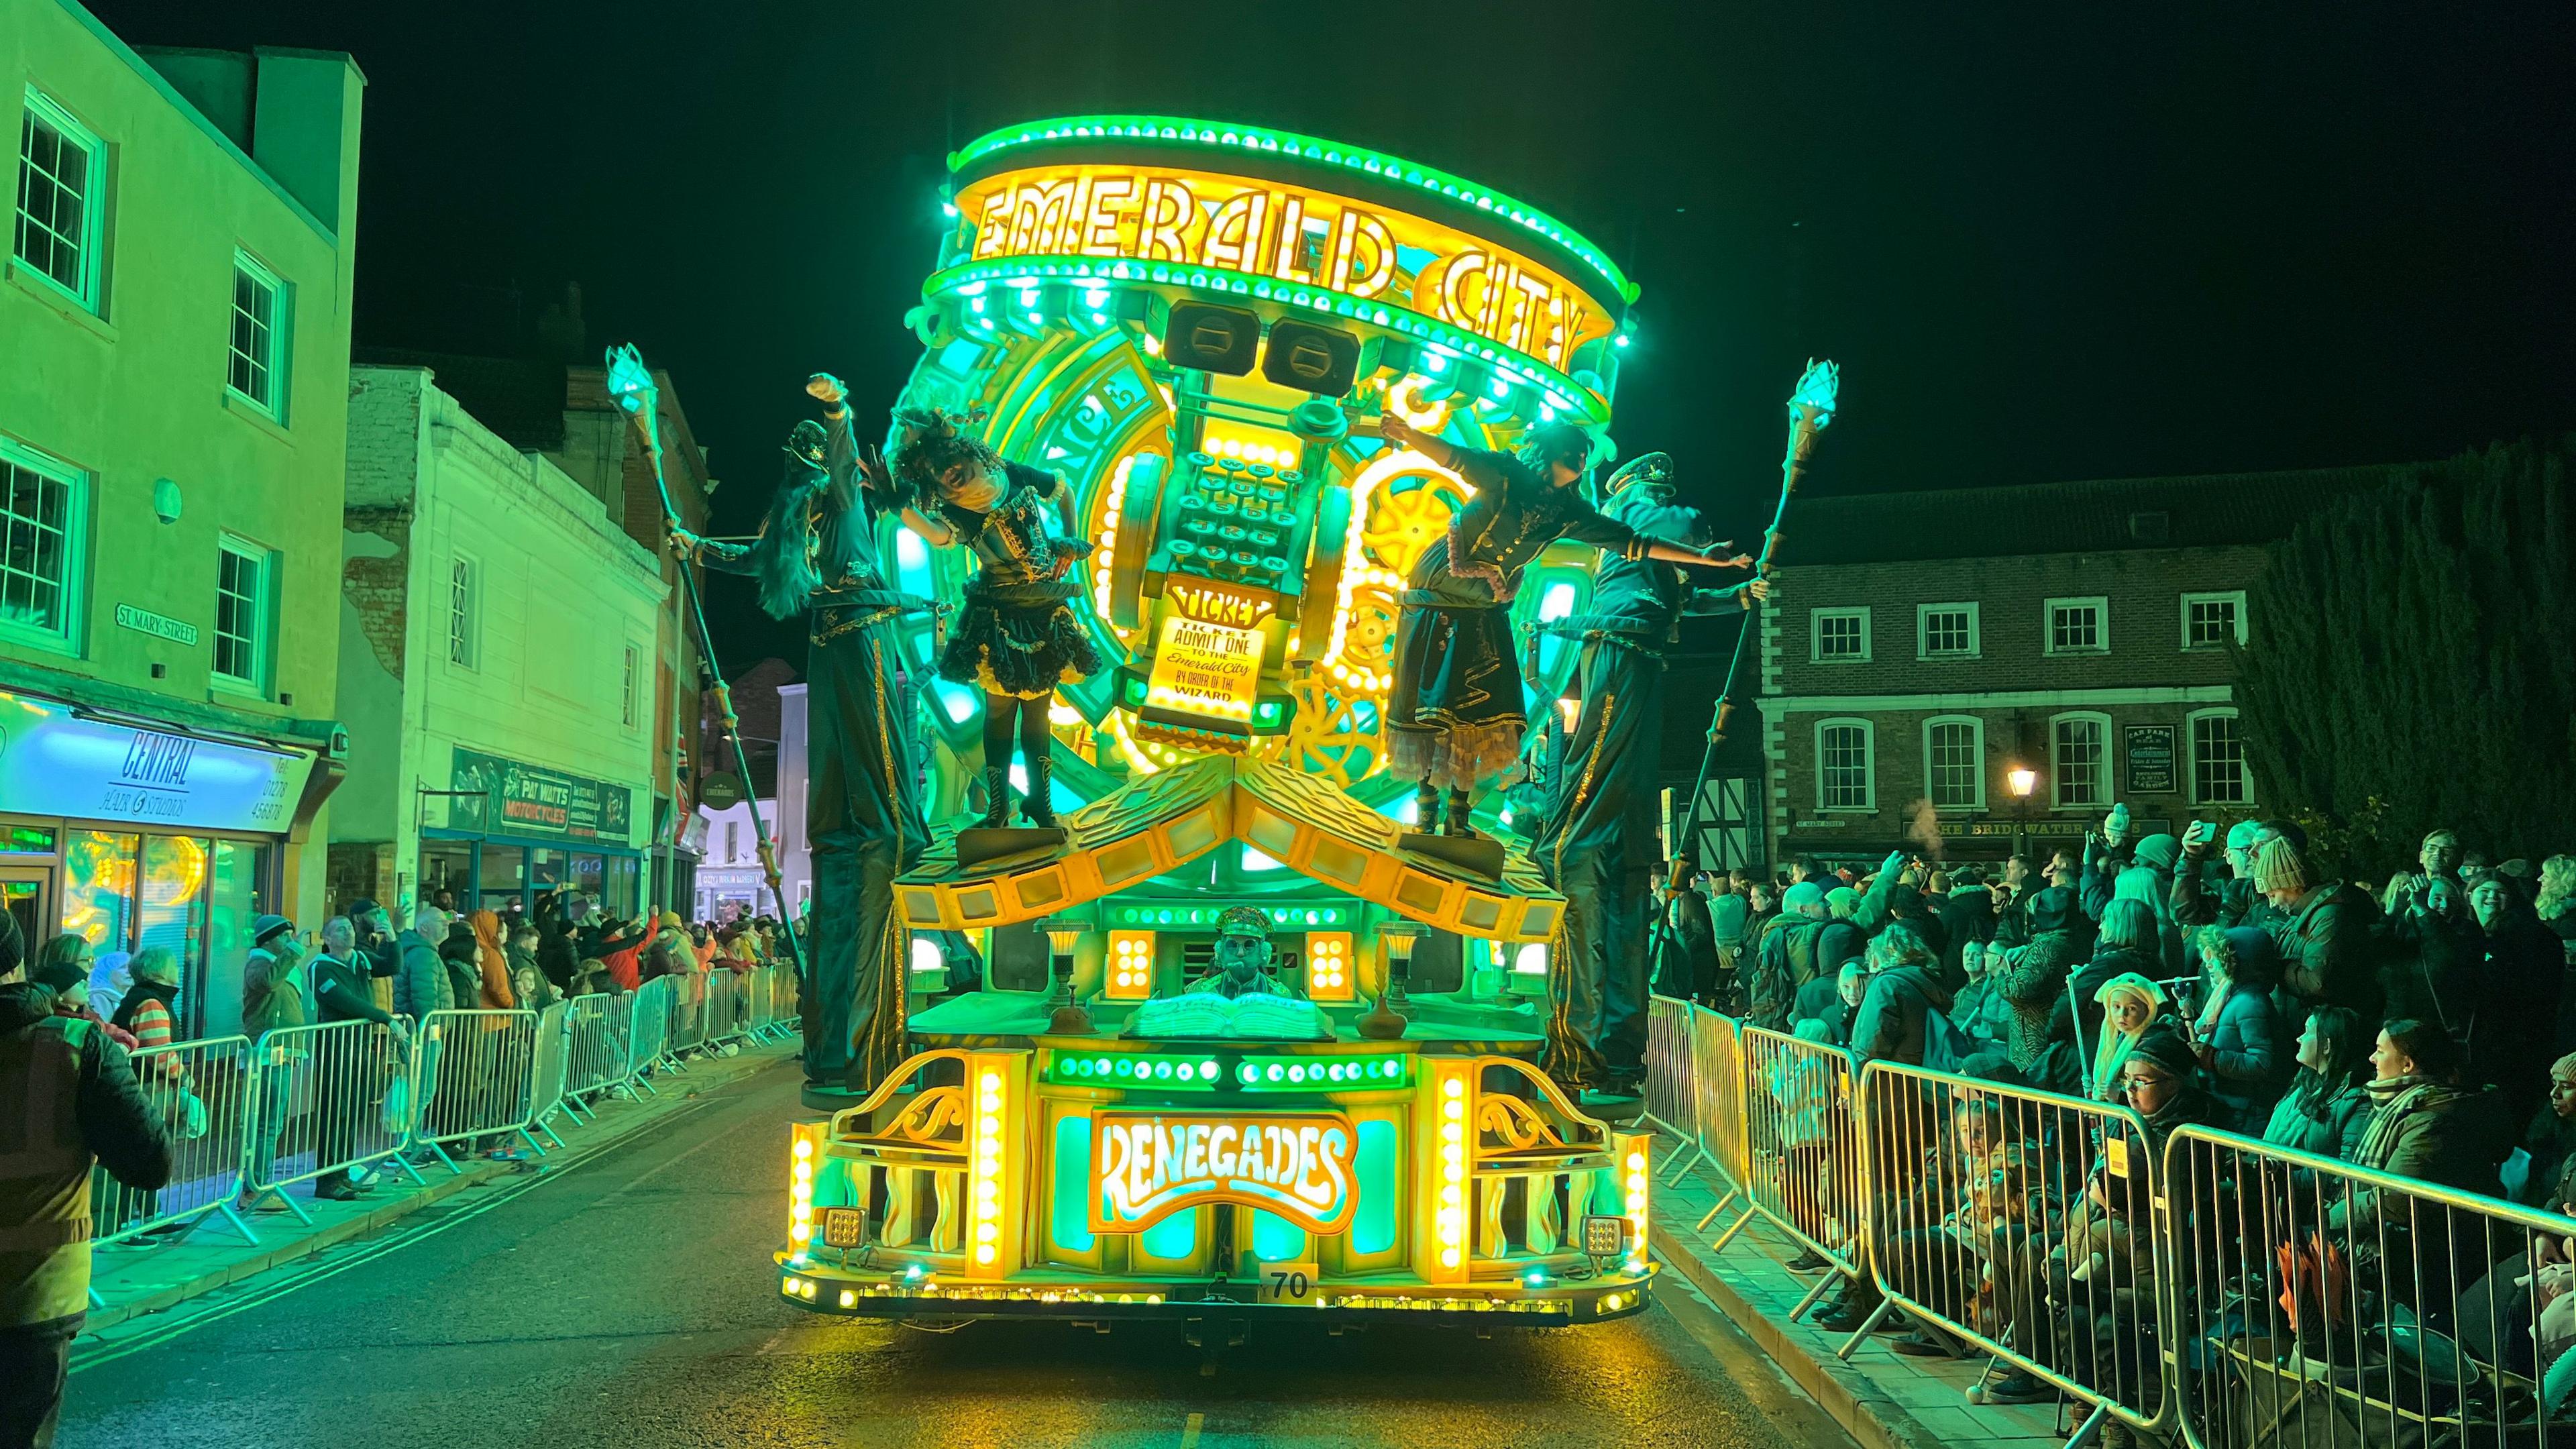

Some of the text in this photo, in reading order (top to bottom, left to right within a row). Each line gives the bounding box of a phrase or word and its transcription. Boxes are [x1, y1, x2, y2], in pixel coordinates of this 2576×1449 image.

[973, 176, 1587, 376] EMERALD CITY
[1195, 453, 1298, 479] Q W E R
[1206, 476, 1220, 486] Y
[1235, 482, 1250, 492] U
[1185, 498, 1291, 523] A S D F
[1226, 527, 1240, 537] K
[1173, 542, 1283, 568] C V B N
[1172, 586, 1272, 626] TICKET
[134, 610, 161, 633] MARY
[164, 621, 195, 642] STREET
[1181, 622, 1250, 638] TICKET
[1174, 629, 1250, 655] ADMIT ONE
[1192, 648, 1228, 660] TO THE
[1167, 652, 1250, 676] Emerald City
[1175, 685, 1232, 702] WIZARD
[1176, 670, 1234, 692] BY ORDER OF THE
[2129, 729, 2170, 739] CAR PARK
[122, 731, 197, 785] CENTRAL
[263, 780, 288, 798] 01278
[522, 780, 539, 800] PAT
[540, 783, 569, 805] WATTS
[99, 790, 186, 817] HAIR STUDIOS
[505, 798, 566, 824] MOTORCYCLES
[1929, 824, 1963, 835] HE
[2092, 822, 2141, 835] AS
[1102, 1124, 1348, 1224] RENEGADES
[1270, 1271, 1308, 1299] 70
